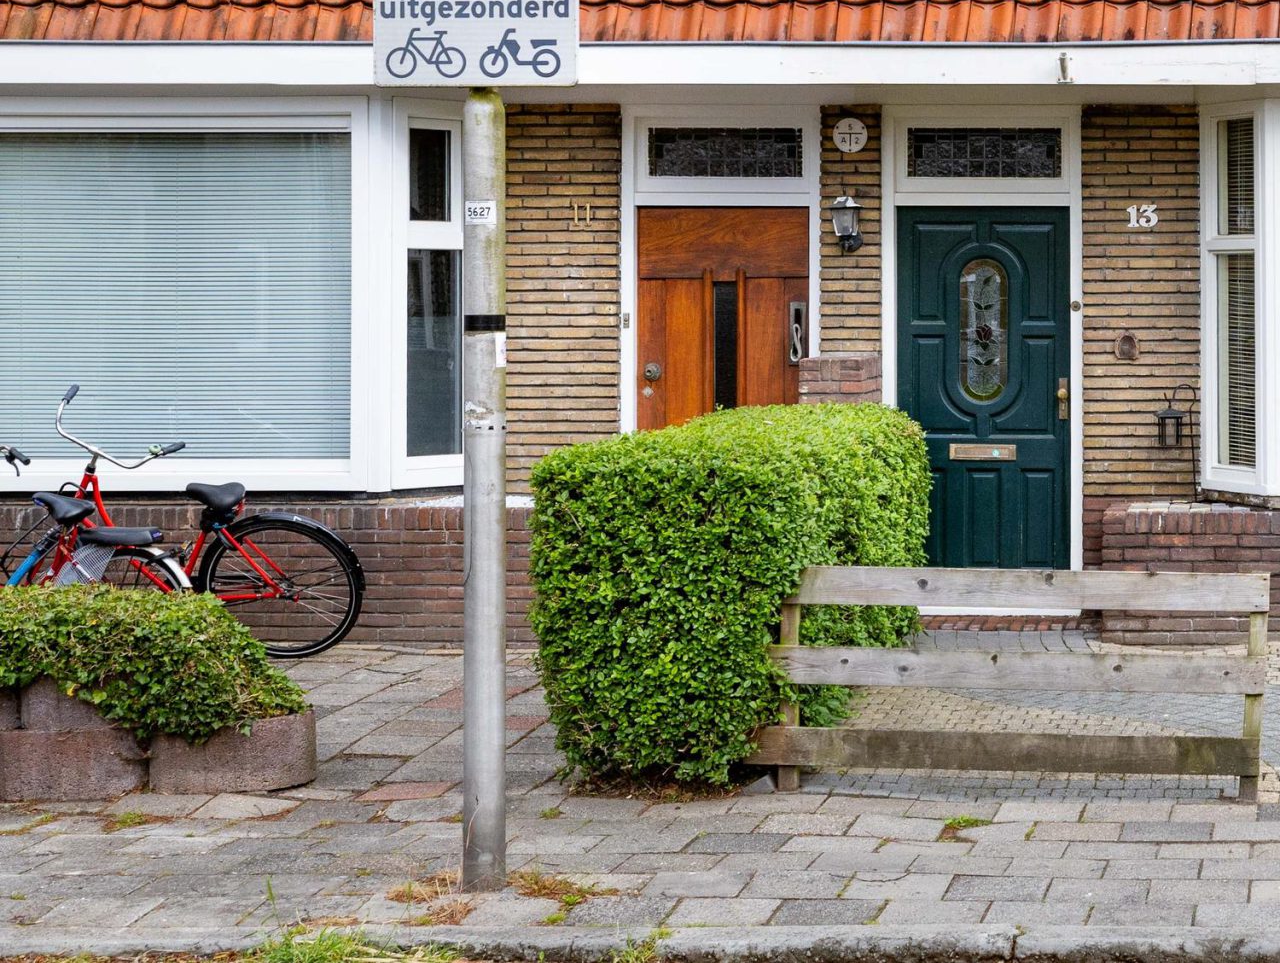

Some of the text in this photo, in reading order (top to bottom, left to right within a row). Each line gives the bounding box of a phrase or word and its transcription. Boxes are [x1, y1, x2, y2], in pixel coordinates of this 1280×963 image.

[467, 206, 491, 217] 5627
[570, 203, 592, 227] 11
[1126, 204, 1159, 227] 13
